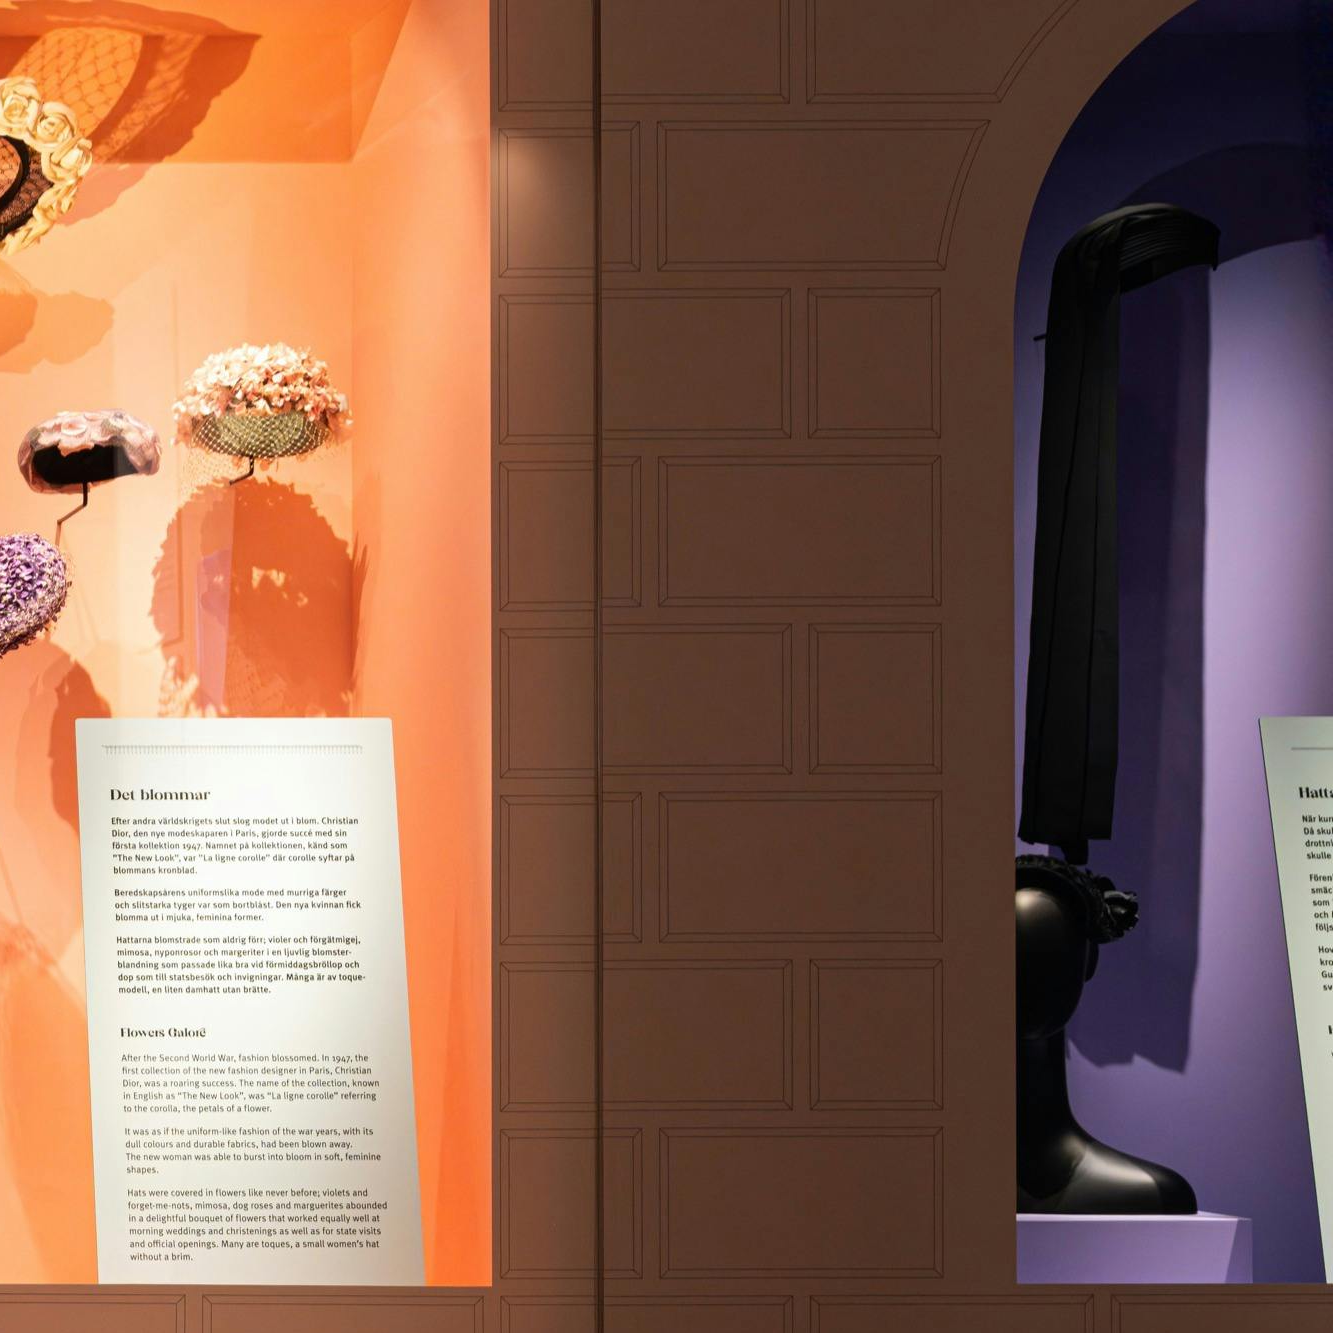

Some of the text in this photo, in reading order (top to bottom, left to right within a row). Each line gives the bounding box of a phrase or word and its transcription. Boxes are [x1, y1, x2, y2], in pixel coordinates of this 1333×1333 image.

[110, 788, 211, 800] Det blommar
[111, 816, 131, 825] Efter
[132, 816, 156, 825] andra
[157, 816, 213, 827] världskrigets
[215, 816, 231, 825] slut
[233, 816, 251, 827] slog
[252, 816, 278, 825] modet
[296, 816, 319, 825] blom.
[321, 816, 359, 825] Christian
[1302, 814, 1316, 823] När
[1304, 826, 1315, 835] Då
[1306, 851, 1332, 860] skulle
[1312, 899, 1330, 907] som
[1314, 911, 1329, 919] och
[117, 960, 159, 970] blandning
[181, 960, 216, 970] passade
[217, 960, 233, 968] lika
[235, 960, 249, 968] bra
[251, 960, 264, 968] vid
[265, 960, 343, 970] förmiddagsbröllop
[344, 960, 359, 968] och
[120, 1026, 206, 1037] Flowers Galore
[121, 1052, 141, 1062] After
[143, 1052, 157, 1062] the
[159, 1052, 190, 1062] Second
[191, 1052, 216, 1062] World
[217, 1052, 237, 1063] War,
[238, 1052, 270, 1062] fashion
[271, 1052, 320, 1062] blossomed.
[331, 1052, 353, 1064] 1947,
[354, 1052, 369, 1062] the
[129, 1226, 164, 1237] morning
[165, 1226, 206, 1237] weddings
[208, 1226, 224, 1235] and
[226, 1226, 277, 1237] christenings
[290, 1226, 309, 1235] well
[322, 1226, 334, 1235] for
[336, 1226, 357, 1235] state
[358, 1226, 381, 1235] visits
